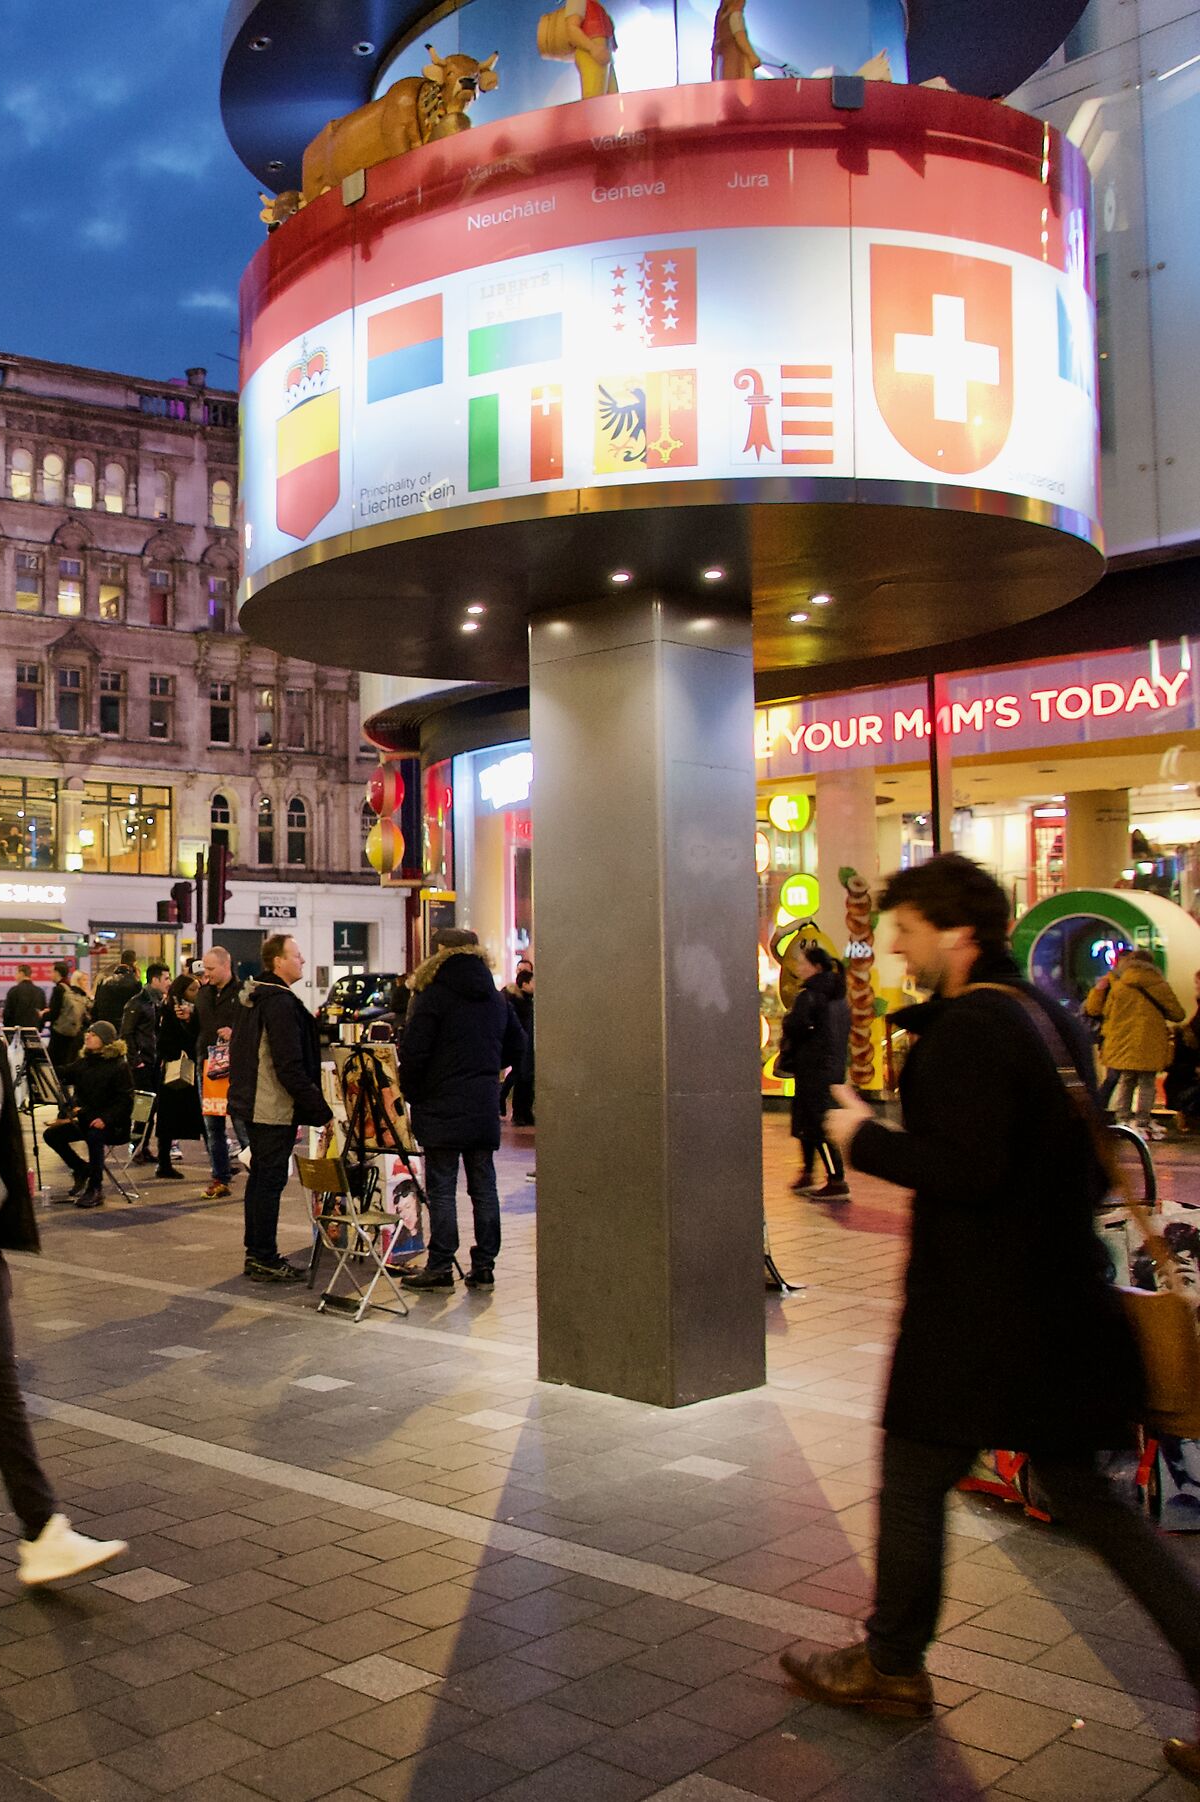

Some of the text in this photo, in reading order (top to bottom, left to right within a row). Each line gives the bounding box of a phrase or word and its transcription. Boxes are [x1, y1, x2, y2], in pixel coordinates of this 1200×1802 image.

[591, 180, 666, 203] Geneva
[727, 172, 769, 188] Jura
[467, 196, 557, 231] Neuchâtel
[360, 472, 432, 498] Principality of
[360, 483, 456, 516] Liechtenstein
[785, 714, 883, 755] YOUR
[894, 696, 1021, 741] MM'S
[1030, 671, 1189, 723] TODAY
[265, 907, 291, 917] HNG
[340, 928, 351, 948] 1
